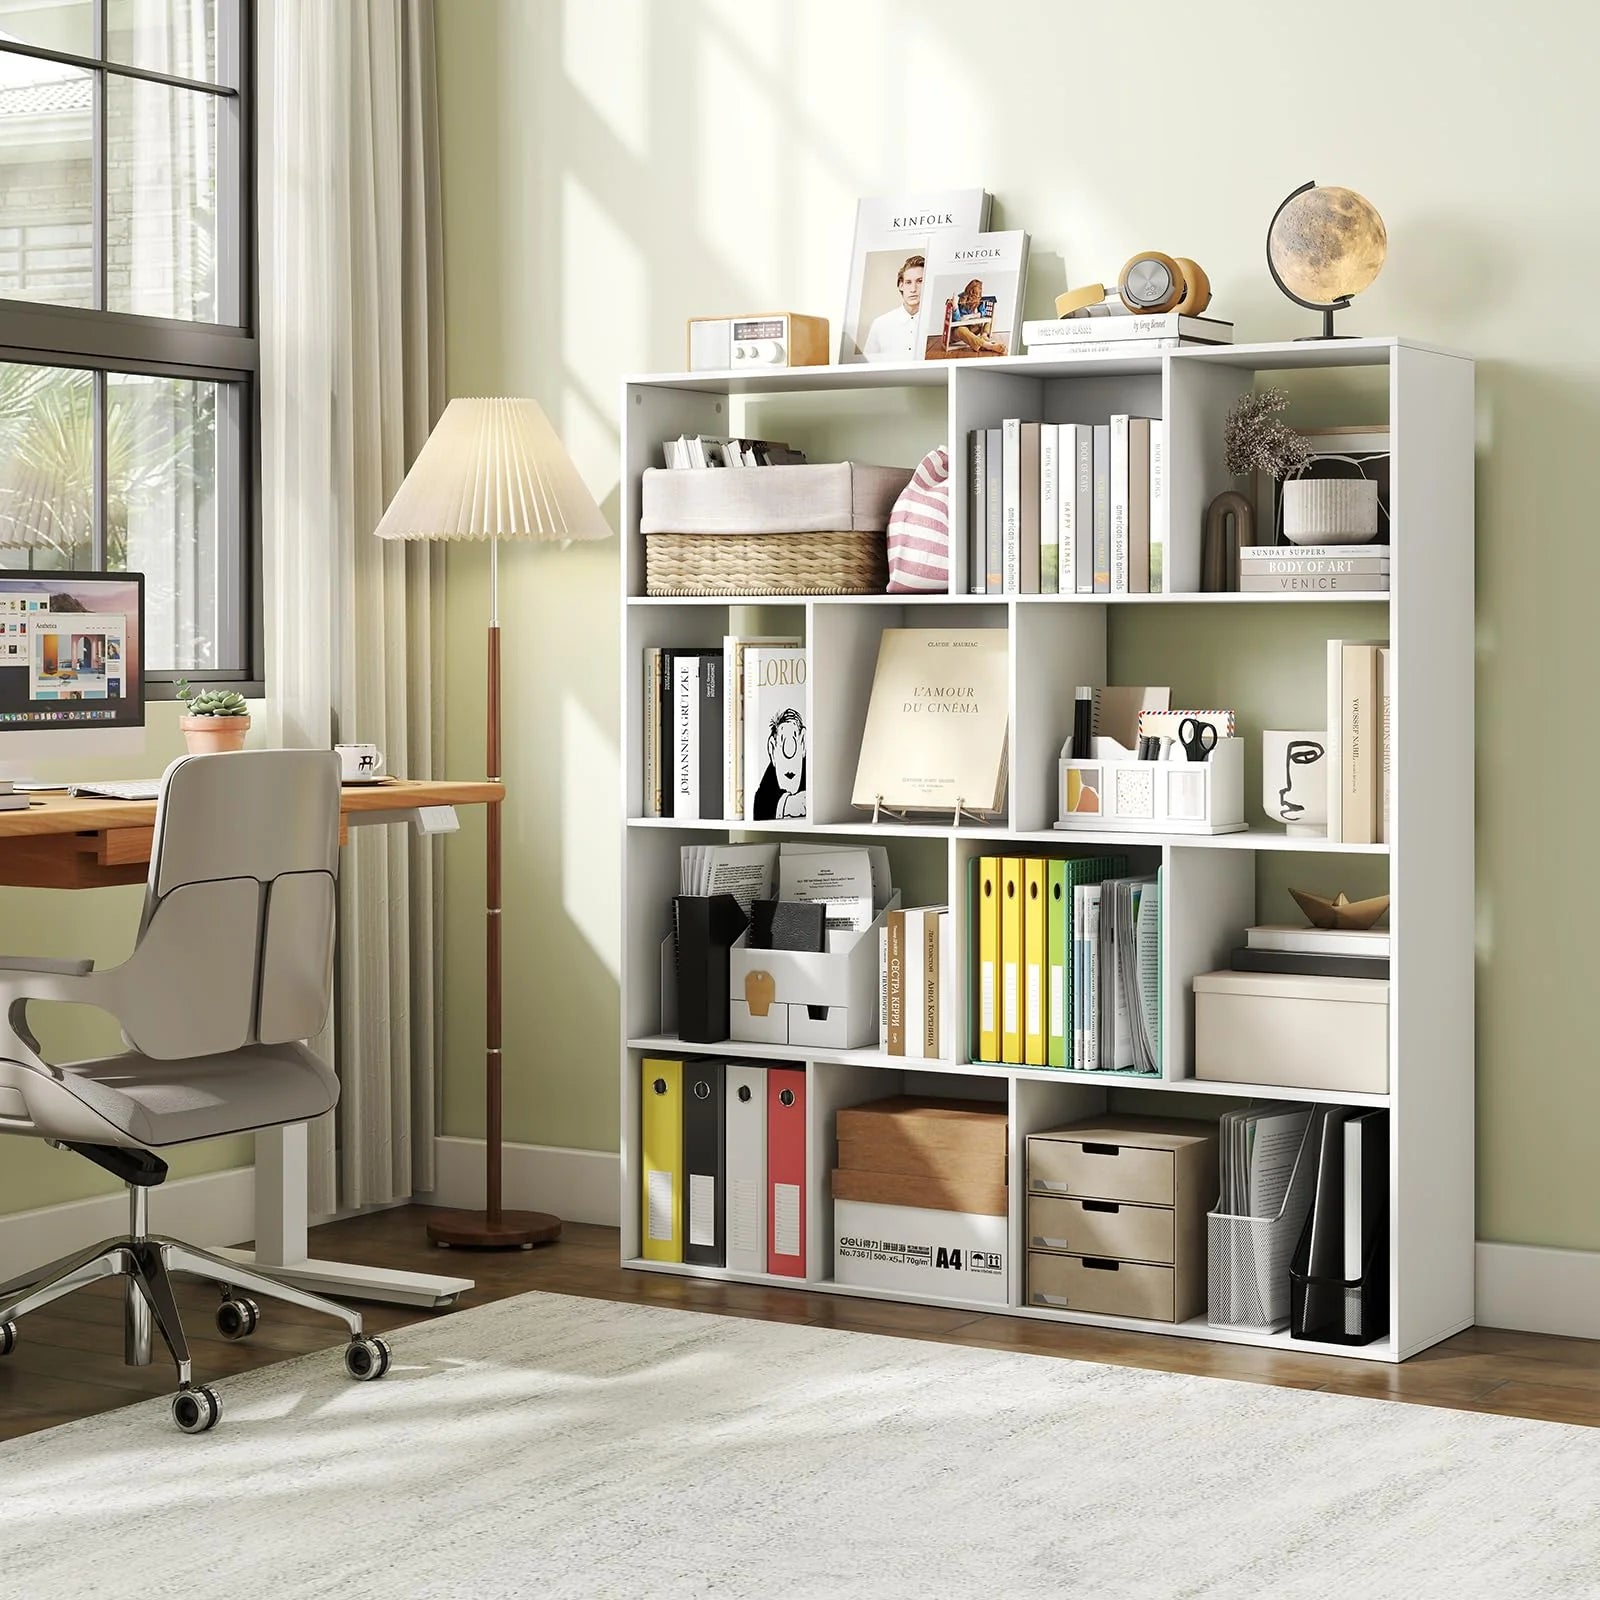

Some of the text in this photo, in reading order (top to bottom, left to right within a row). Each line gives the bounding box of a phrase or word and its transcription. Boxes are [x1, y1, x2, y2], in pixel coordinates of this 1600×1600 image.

[893, 213, 953, 228] KINFOLK
[954, 248, 1001, 260] KINFOLK
[974, 444, 982, 496] BOOK OF CATS
[1044, 447, 1053, 501] BOOK OF DOGS
[1080, 440, 1089, 493] BOOK OF CATS
[1154, 443, 1162, 498] BOOK OF DOGS
[1006, 507, 1016, 591] american south animals
[1064, 501, 1072, 575] HAPPY ANIMALS
[1115, 504, 1125, 590] american south animals
[1251, 548, 1326, 557] SUNDAY SUPPERS
[1268, 560, 1354, 573] BODY OF ART
[1280, 577, 1337, 589] VENICE
[903, 701, 980, 713] DU CINÉMA
[1352, 697, 1360, 735] YOUSSEF
[680, 728, 690, 795] JOHANNES
[1352, 736, 1360, 761] NABIL
[891, 958, 900, 994] СЕСТРА
[891, 997, 900, 1027] КЕРРИ
[935, 1246, 962, 1271] A4
